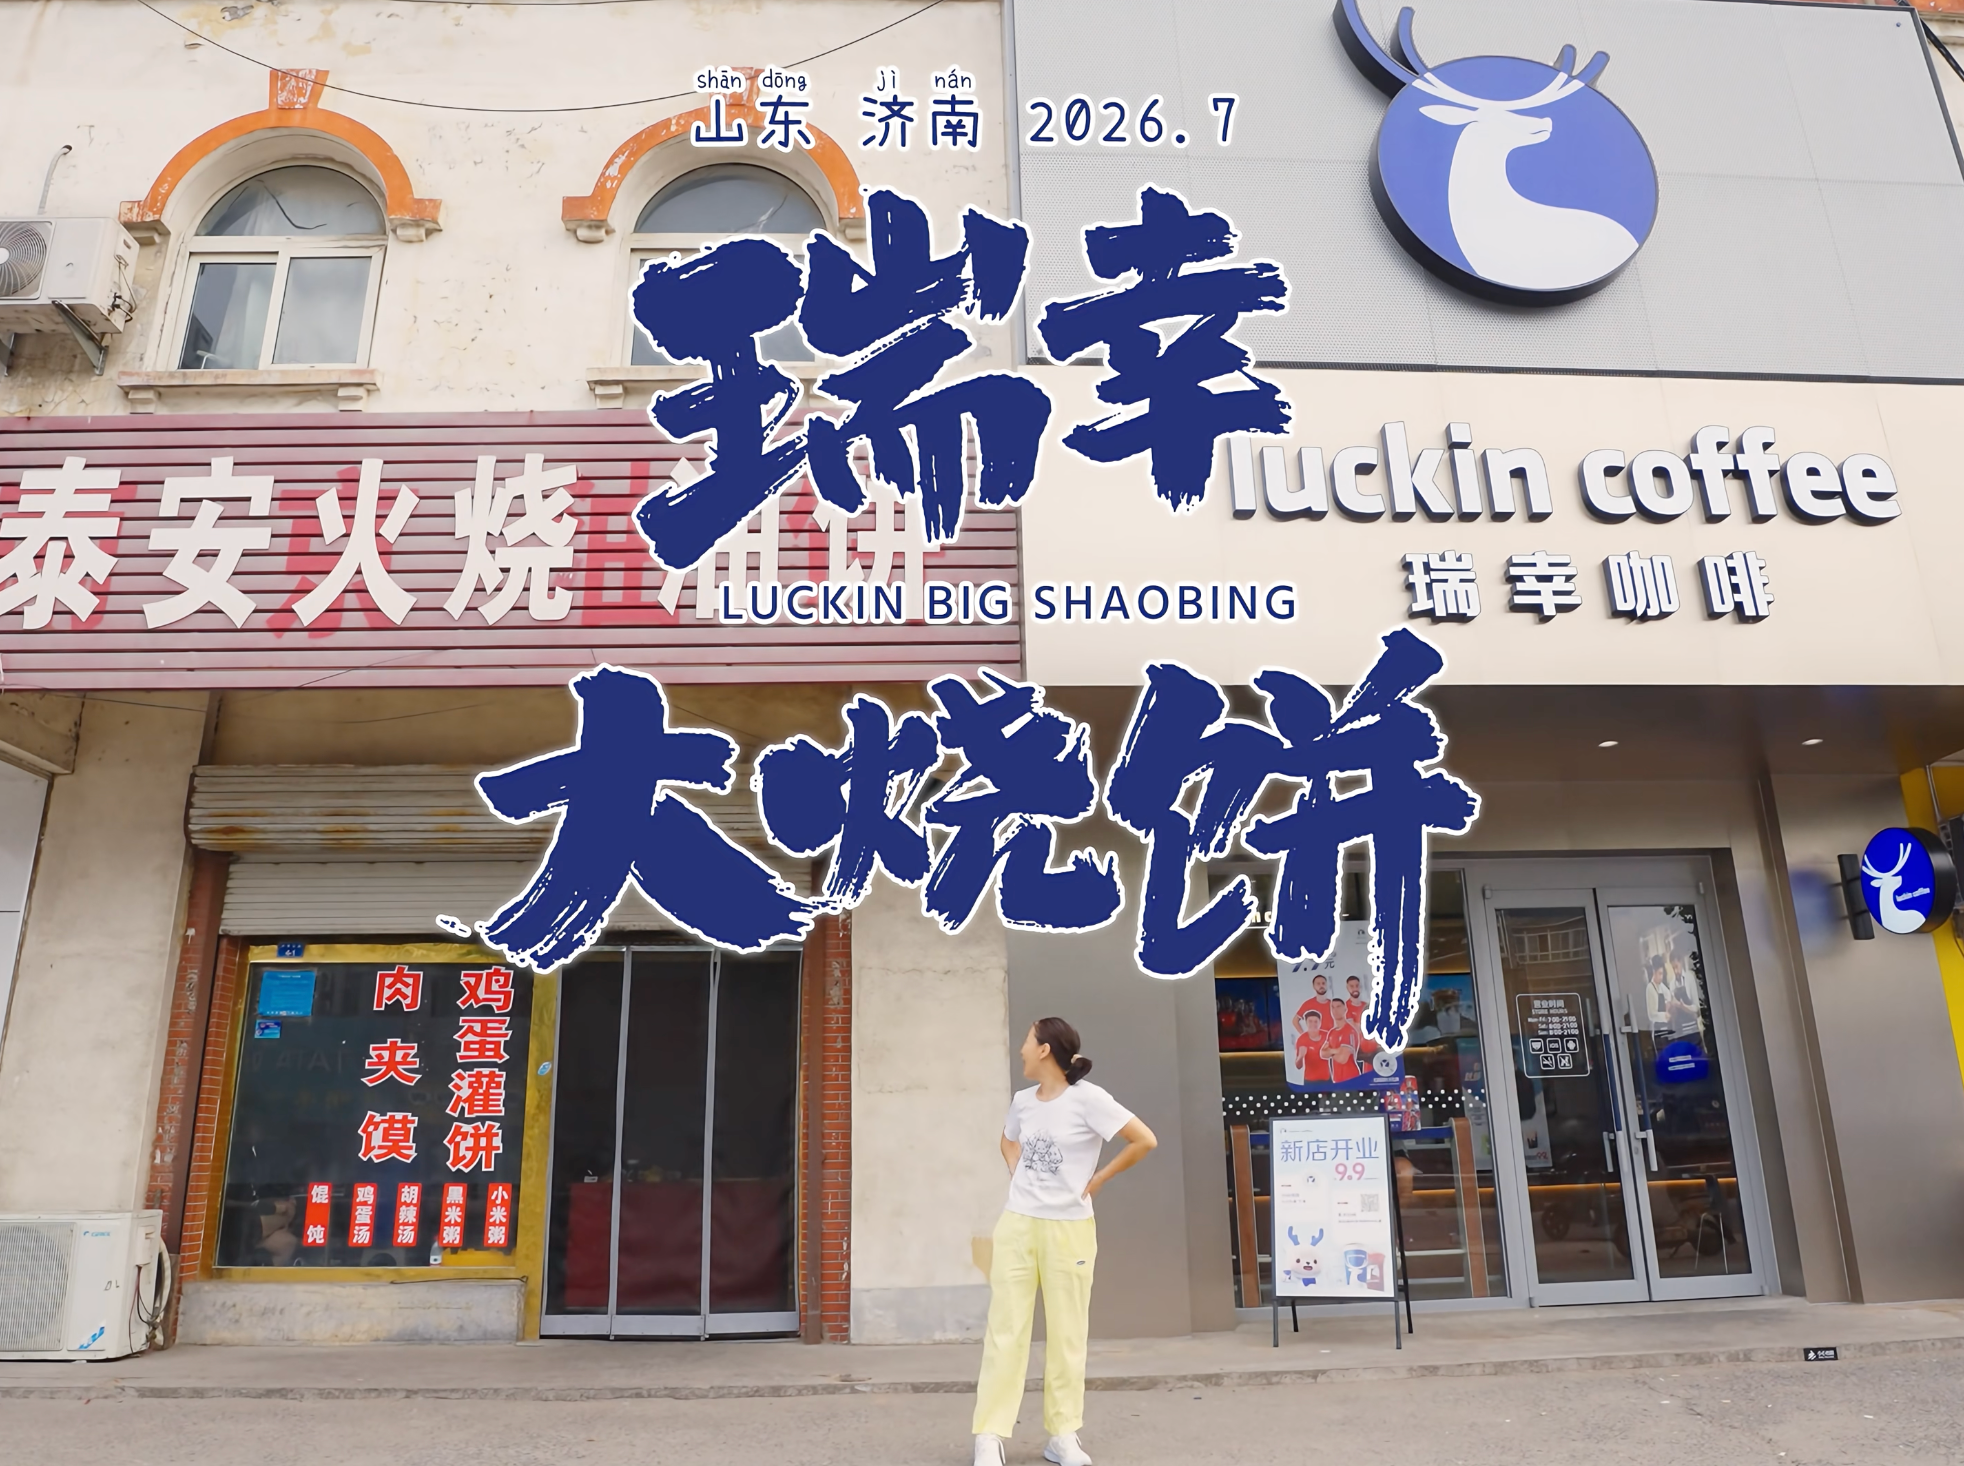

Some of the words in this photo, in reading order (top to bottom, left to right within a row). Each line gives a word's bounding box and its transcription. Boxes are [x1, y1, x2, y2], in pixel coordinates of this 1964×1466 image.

[1228, 420, 1553, 521] luckin
[1580, 425, 1902, 526] coffee
[1402, 549, 1776, 624] 瑞幸咖啡
[358, 965, 424, 1163] 肉夹馍
[445, 965, 515, 1173] 鸡蛋灌饼
[1280, 1136, 1380, 1163] 新店开业
[1334, 1162, 1366, 1181] 9.9
[306, 1184, 329, 1245] 馄饨
[352, 1185, 375, 1245] 鸡蛋汤
[396, 1185, 419, 1245] 胡辣汤
[442, 1185, 464, 1245] 黑米粥
[487, 1185, 510, 1245] 小米粥
